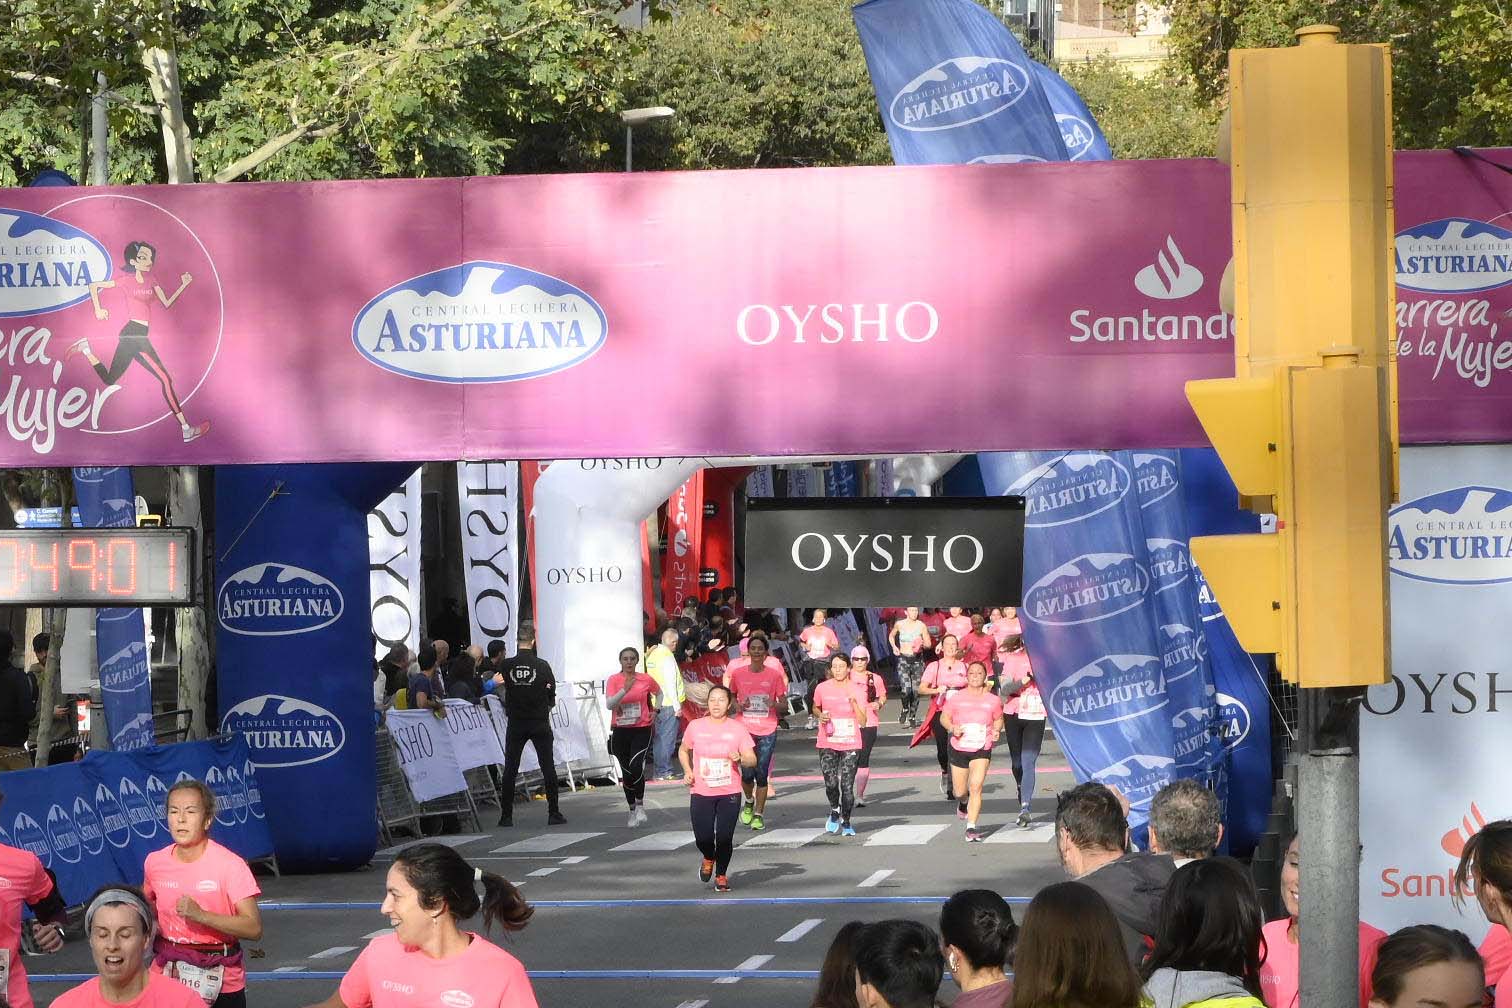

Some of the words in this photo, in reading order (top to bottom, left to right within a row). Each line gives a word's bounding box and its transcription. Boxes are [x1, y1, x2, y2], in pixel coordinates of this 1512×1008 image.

[15, 245, 87, 257] LECHERA
[1409, 244, 1459, 252] CENTRAL
[1465, 241, 1512, 251] LECHER
[1395, 248, 1512, 274] STURIAN
[412, 303, 491, 317] CENTRAL
[499, 302, 579, 315] LECHERA
[1396, 299, 1490, 327] arrera
[372, 308, 586, 353] ASTURIANA
[737, 301, 939, 345] OYSHO
[1070, 309, 1236, 342] Santand
[1419, 329, 1436, 356] la
[1432, 323, 1512, 388] Muje
[1416, 520, 1483, 531] CENTRAL
[791, 532, 985, 574] OYSHO
[547, 565, 623, 586] OYSHO
[234, 587, 276, 597] CENTRAL
[281, 587, 330, 596] LECHERA
[221, 592, 334, 619] ASTURIANA
[516, 670, 530, 679] BP
[1362, 671, 1512, 715] OYSH
[236, 720, 277, 728] CENTRAL
[282, 719, 330, 727] LECHERA
[243, 729, 335, 749] TURIANA
